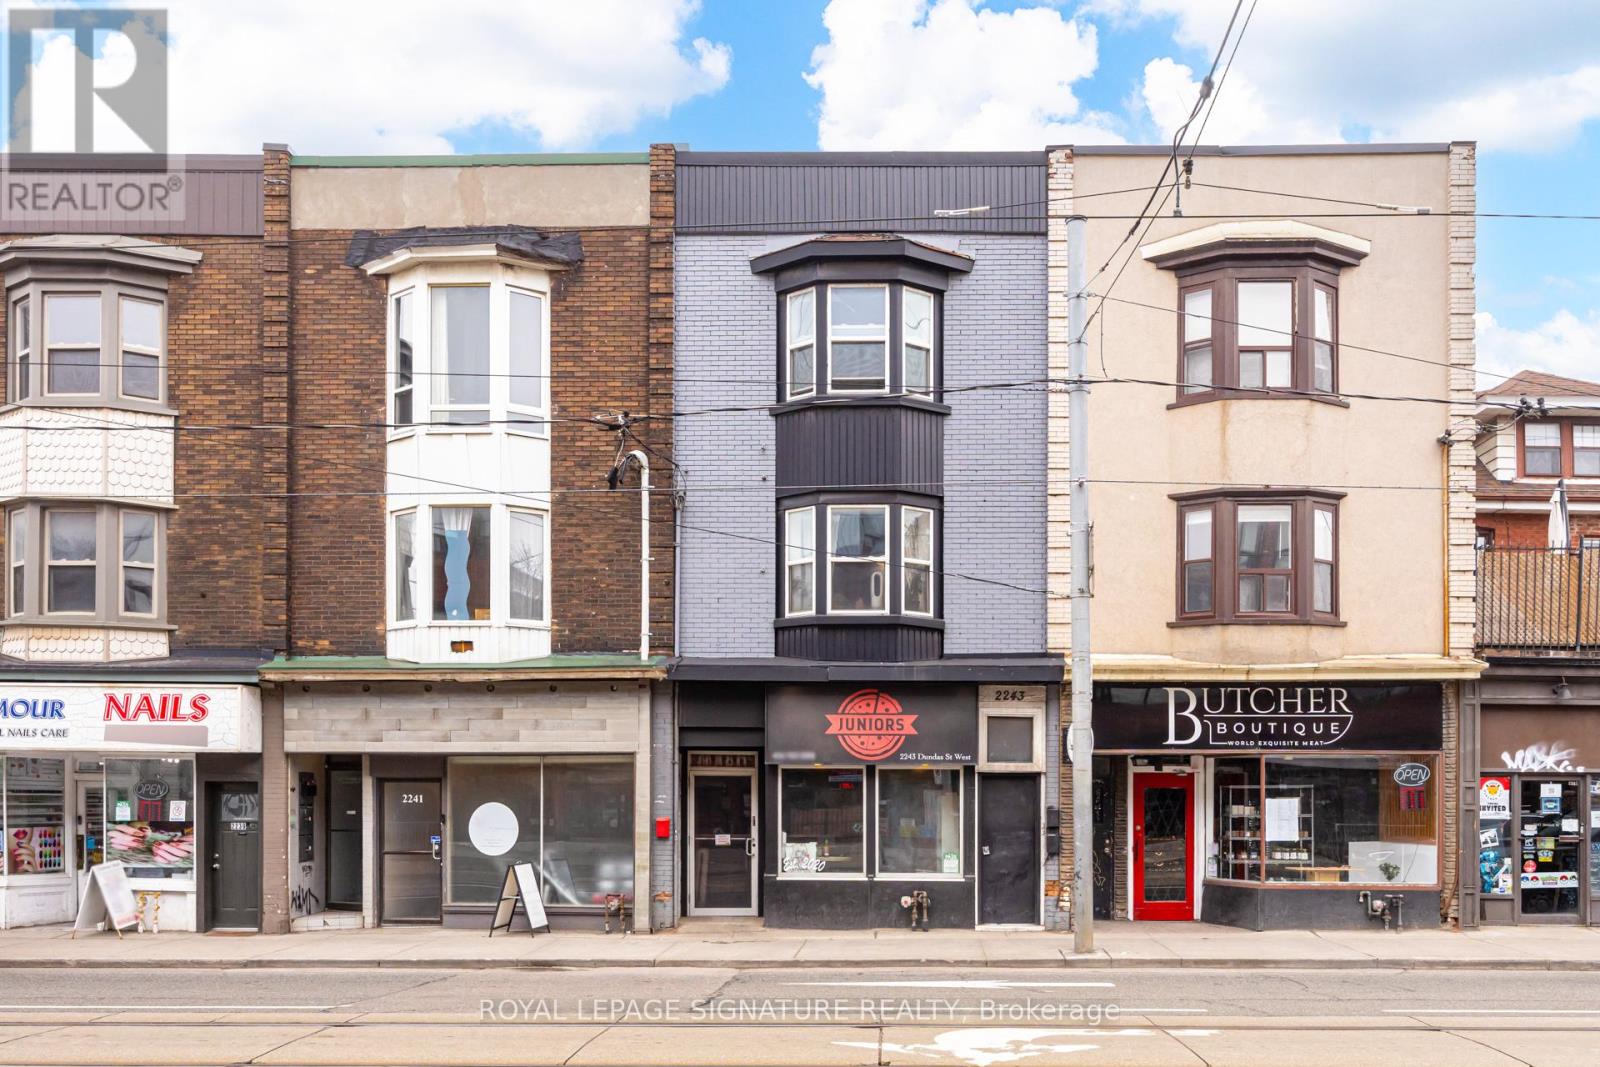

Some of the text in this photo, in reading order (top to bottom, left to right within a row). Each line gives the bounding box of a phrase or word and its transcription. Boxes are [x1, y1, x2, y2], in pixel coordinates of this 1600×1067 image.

[995, 690, 1025, 701] 2243
[103, 693, 211, 722] NAILS
[1162, 687, 1353, 745] BUTCHER
[838, 718, 905, 731] JUNIORS
[1216, 722, 1340, 736] BOUTIQUE
[7, 727, 37, 737] NAILS
[40, 727, 70, 738] CARE
[917, 752, 944, 760] Dundas
[1396, 769, 1427, 780] OPEN
[136, 783, 166, 795] OPEN
[402, 794, 424, 803] 2241
